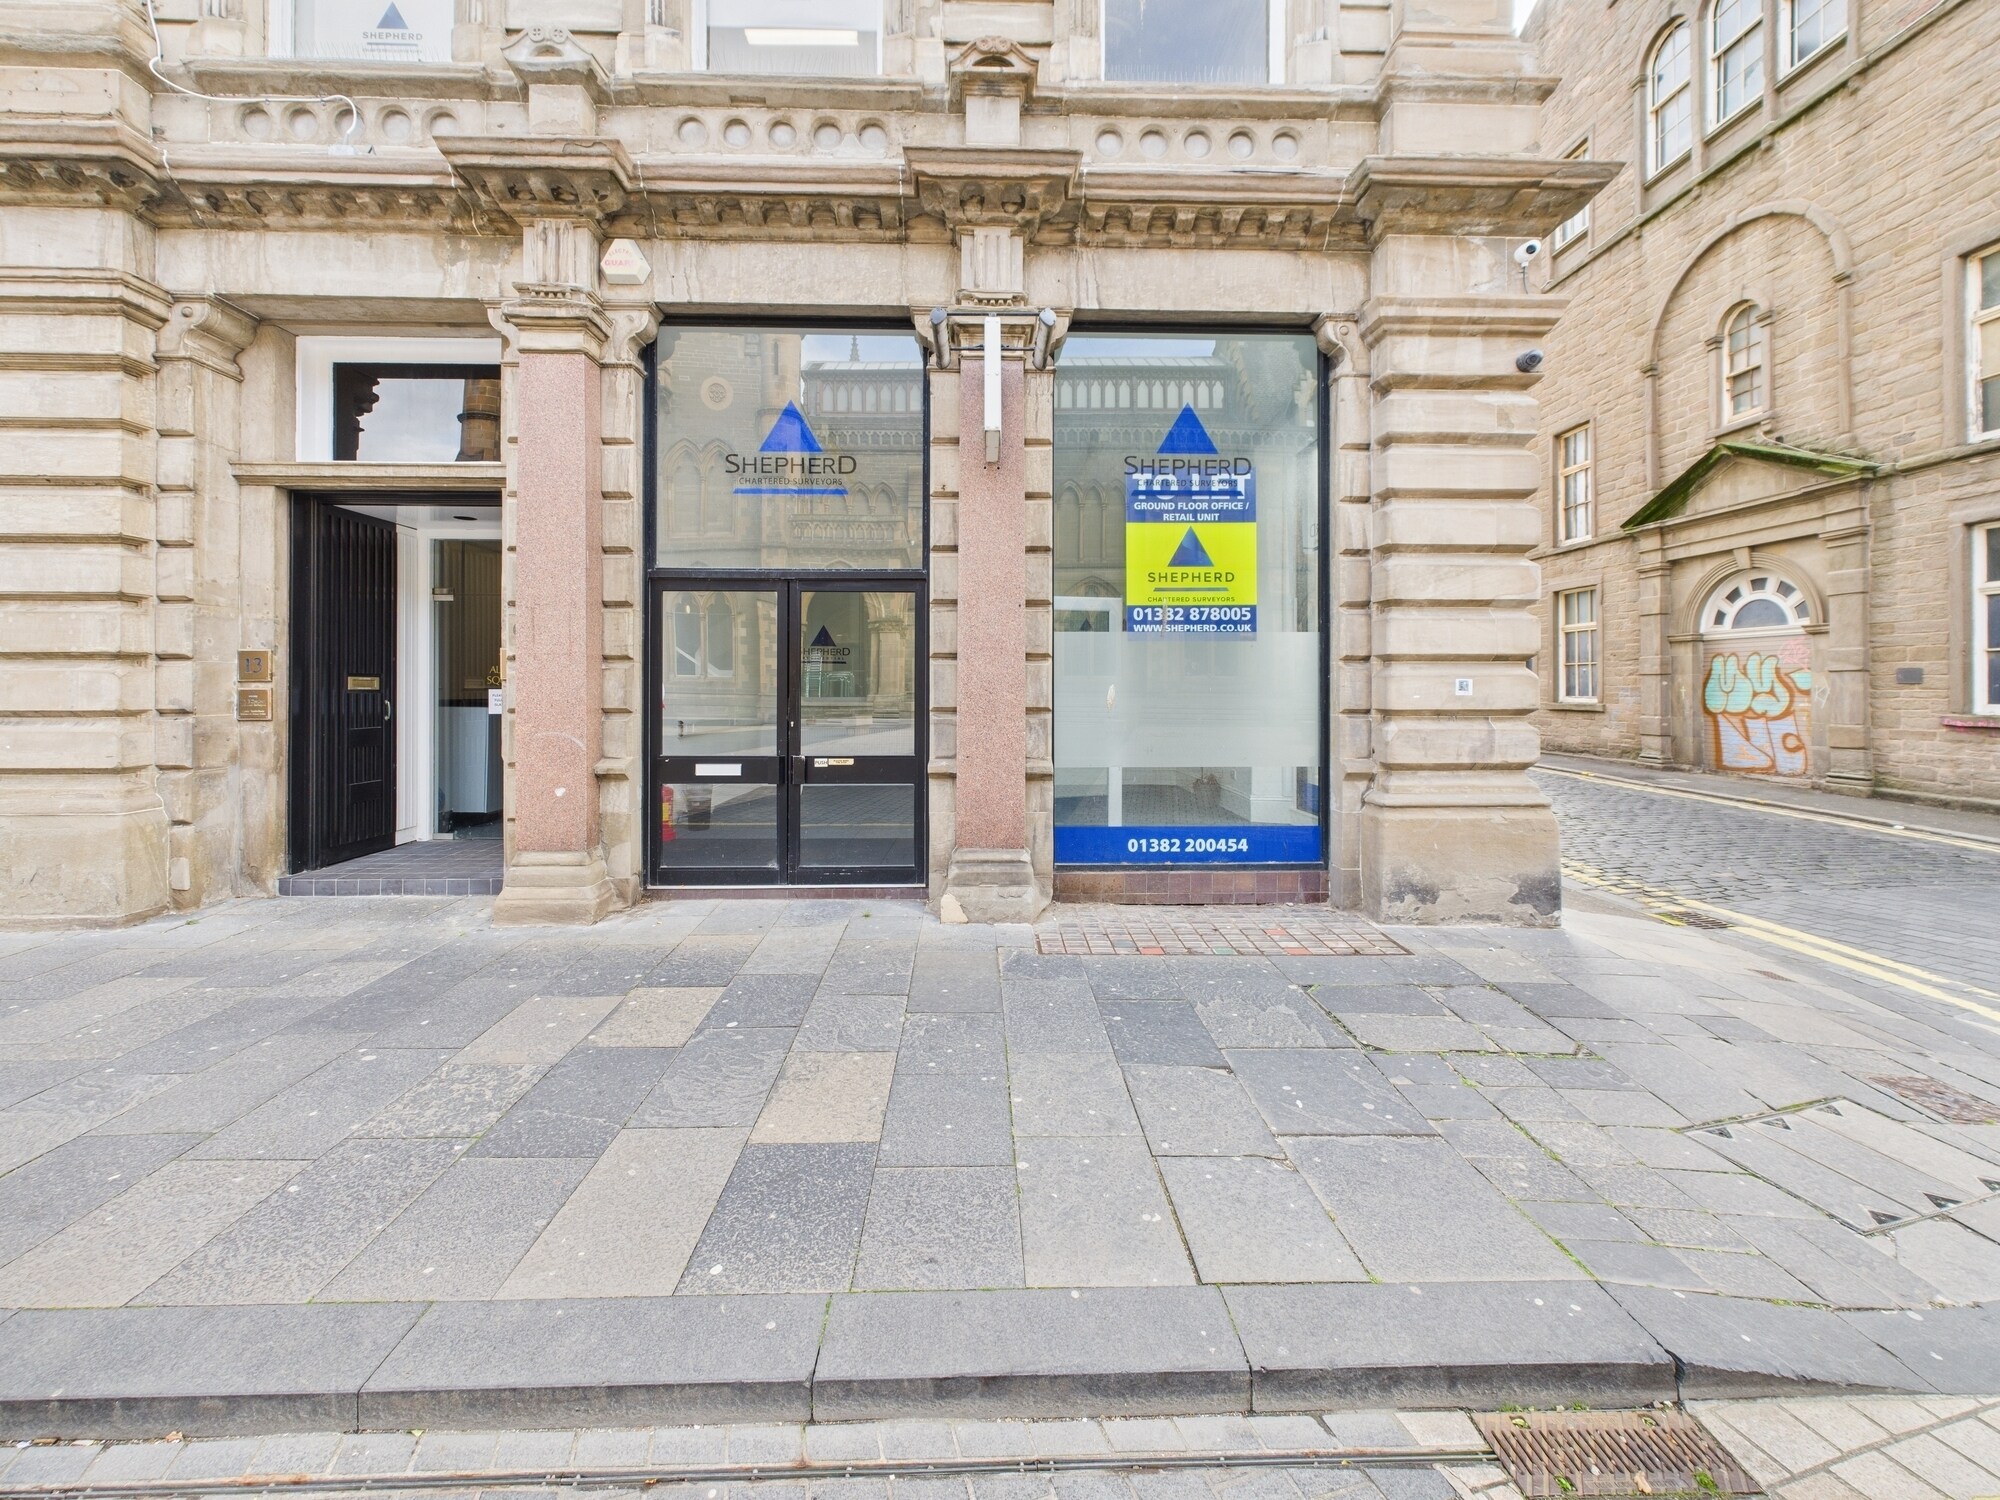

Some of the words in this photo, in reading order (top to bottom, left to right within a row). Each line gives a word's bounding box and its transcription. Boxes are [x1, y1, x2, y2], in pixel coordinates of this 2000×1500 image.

[362, 31, 423, 41] SHEPHERD
[725, 453, 857, 475] SHEPHERD
[1124, 455, 1252, 476] SHEPHERD
[739, 476, 790, 486] CHARTERED
[792, 477, 843, 486] SURVEYORS
[1136, 479, 1187, 488] CHARTERED
[1189, 479, 1238, 488] SURVEYORS
[1132, 473, 1179, 500] TO
[1191, 473, 1251, 500] LET
[1134, 501, 1175, 511] GROUND
[1177, 501, 1209, 511] FLOOR
[1211, 501, 1244, 511] OFFICE
[1245, 501, 1250, 511] /
[1163, 513, 1195, 521] RETAIL
[1197, 513, 1220, 521] UNIT
[1147, 572, 1235, 583] SHEPHERD
[1133, 607, 1184, 621] 01382
[1189, 607, 1251, 621] 878005
[1133, 624, 1252, 632] WWWSHEPHERD.CO.UK
[802, 647, 851, 656] HEPHERD
[245, 657, 262, 673] 13
[490, 665, 500, 673] AL
[486, 675, 502, 685] SQ
[1127, 838, 1181, 853] 01382
[1184, 838, 1249, 853] 200454
